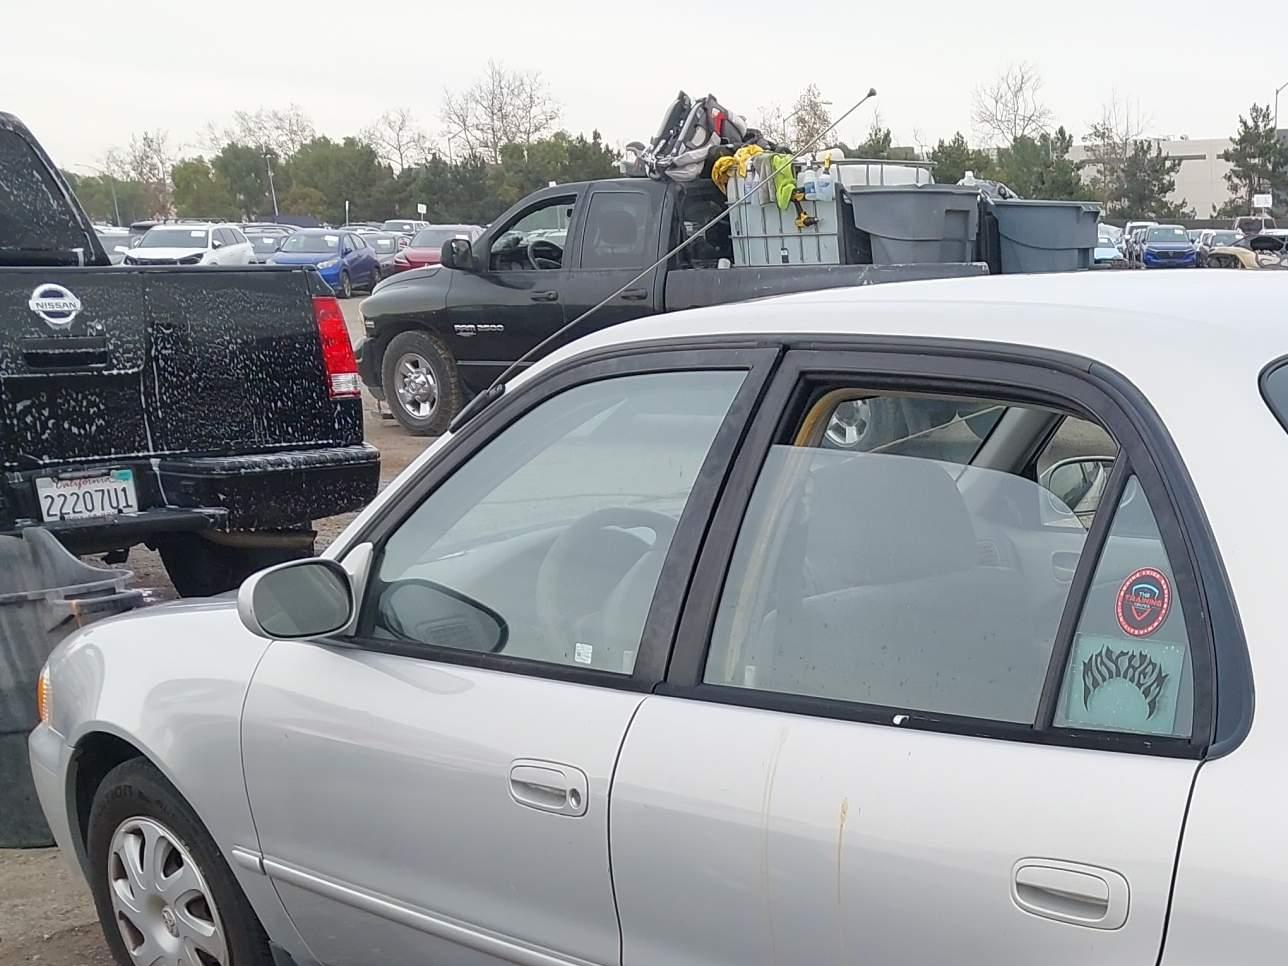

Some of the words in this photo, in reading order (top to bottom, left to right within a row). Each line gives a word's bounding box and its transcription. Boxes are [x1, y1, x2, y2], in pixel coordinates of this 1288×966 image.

[35, 301, 77, 310] NISSAN
[55, 477, 112, 490] California
[44, 486, 133, 518] 22207U1
[1125, 594, 1162, 607] TRAINING
